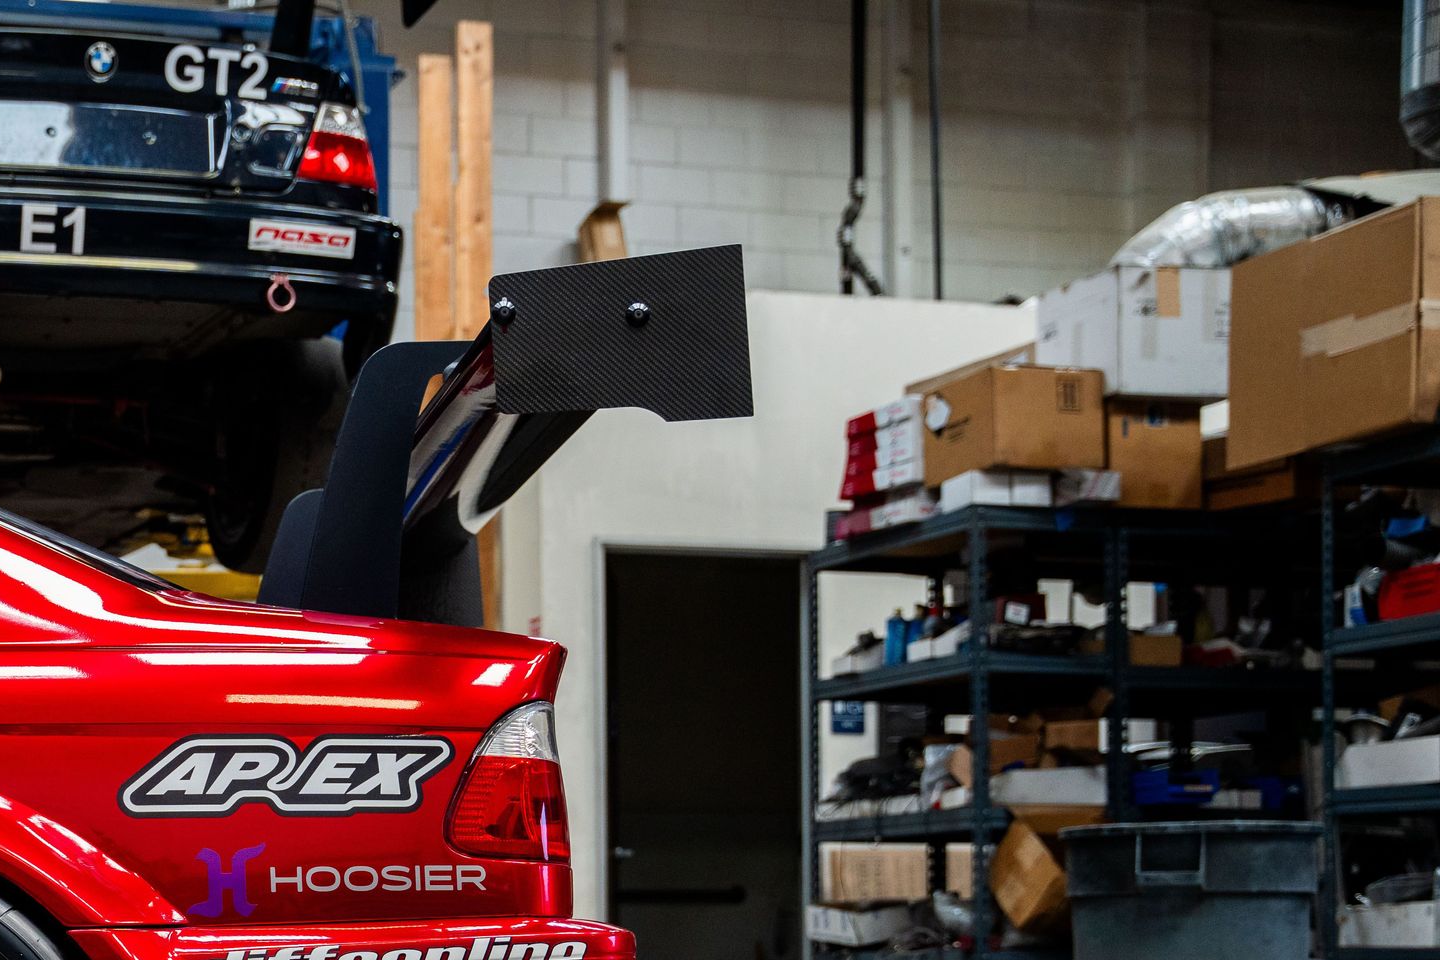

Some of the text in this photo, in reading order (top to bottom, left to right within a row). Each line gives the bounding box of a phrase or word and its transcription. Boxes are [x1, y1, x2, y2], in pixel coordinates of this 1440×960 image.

[164, 44, 269, 100] GT2
[20, 204, 86, 256] E1
[255, 226, 352, 248] nasa
[268, 863, 488, 893] HOOSIER
